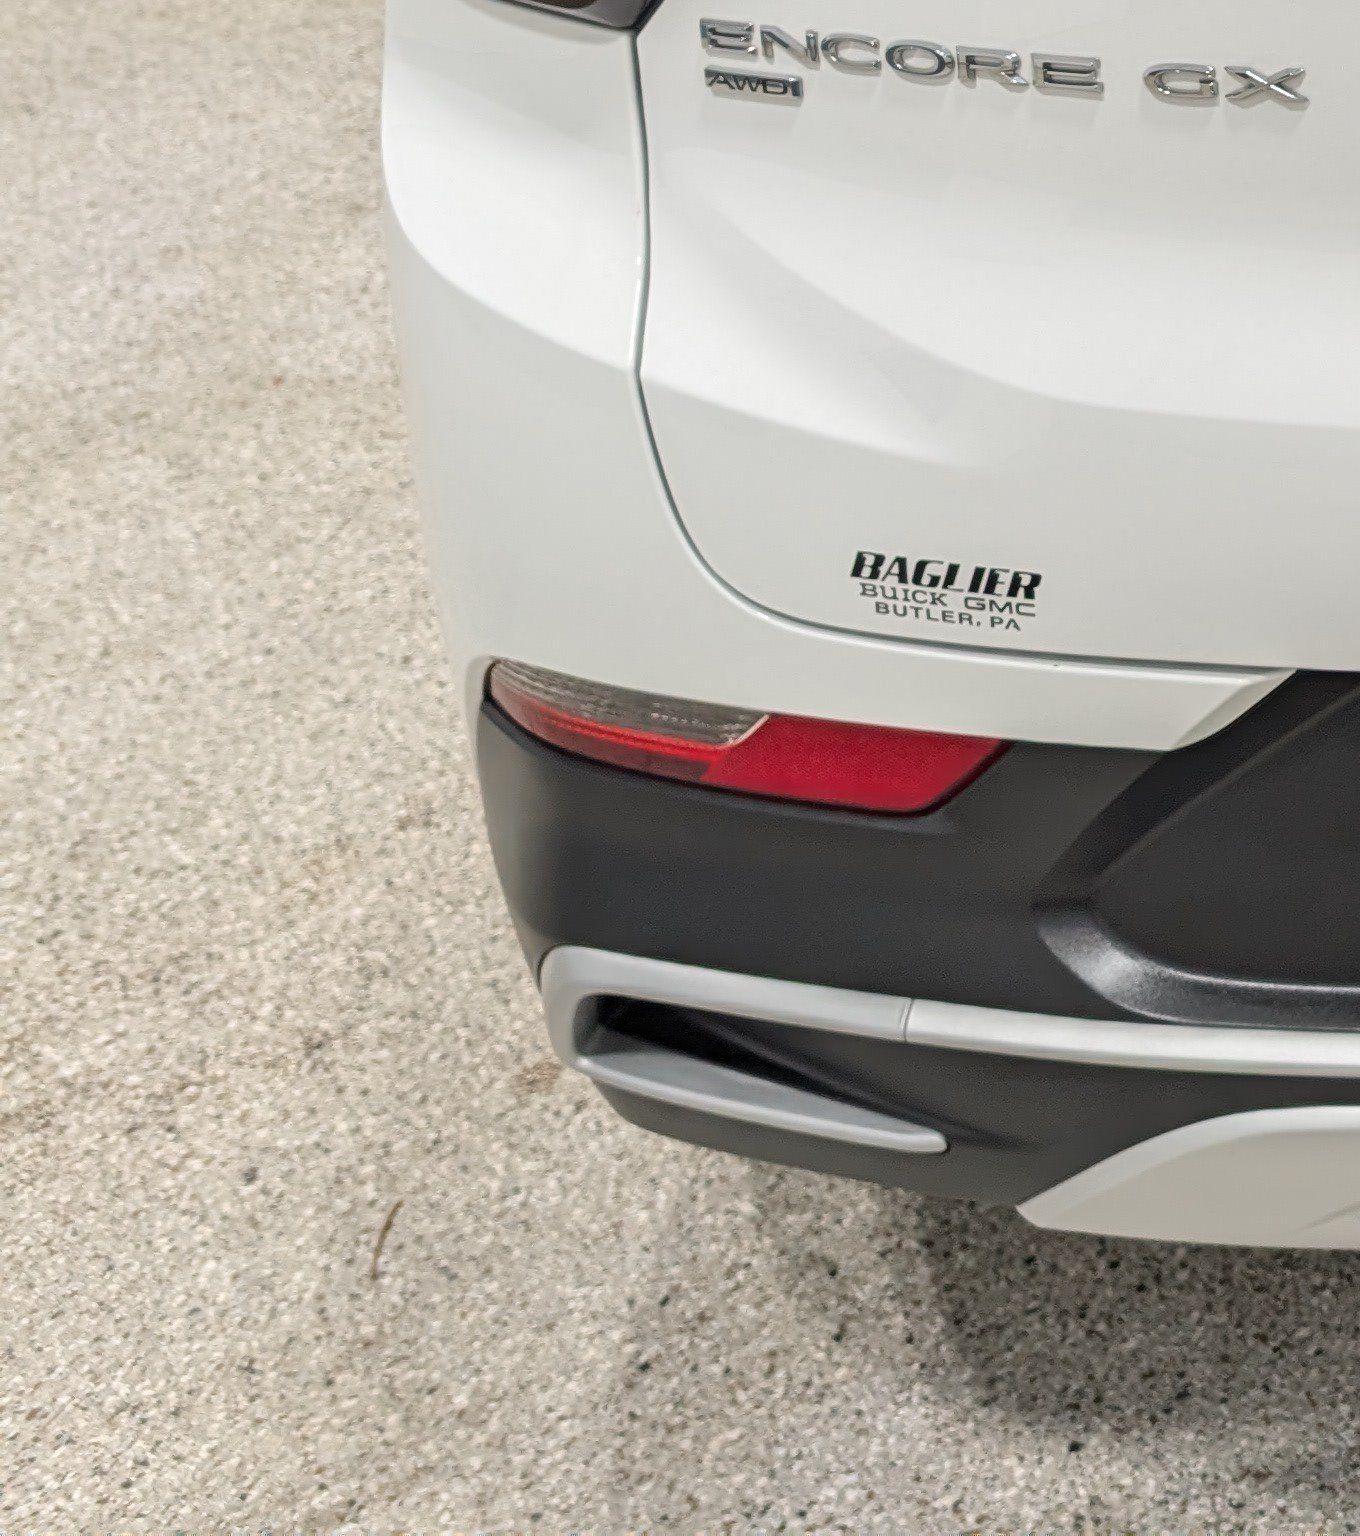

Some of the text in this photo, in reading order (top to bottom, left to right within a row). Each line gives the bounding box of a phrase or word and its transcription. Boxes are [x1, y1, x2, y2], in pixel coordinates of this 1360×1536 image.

[699, 17, 1310, 104] ENCORE GX
[707, 71, 790, 95] AWD
[850, 550, 1042, 599] BAGLIER
[859, 582, 1036, 617] BUICK GMC
[990, 616, 1021, 631] PA
